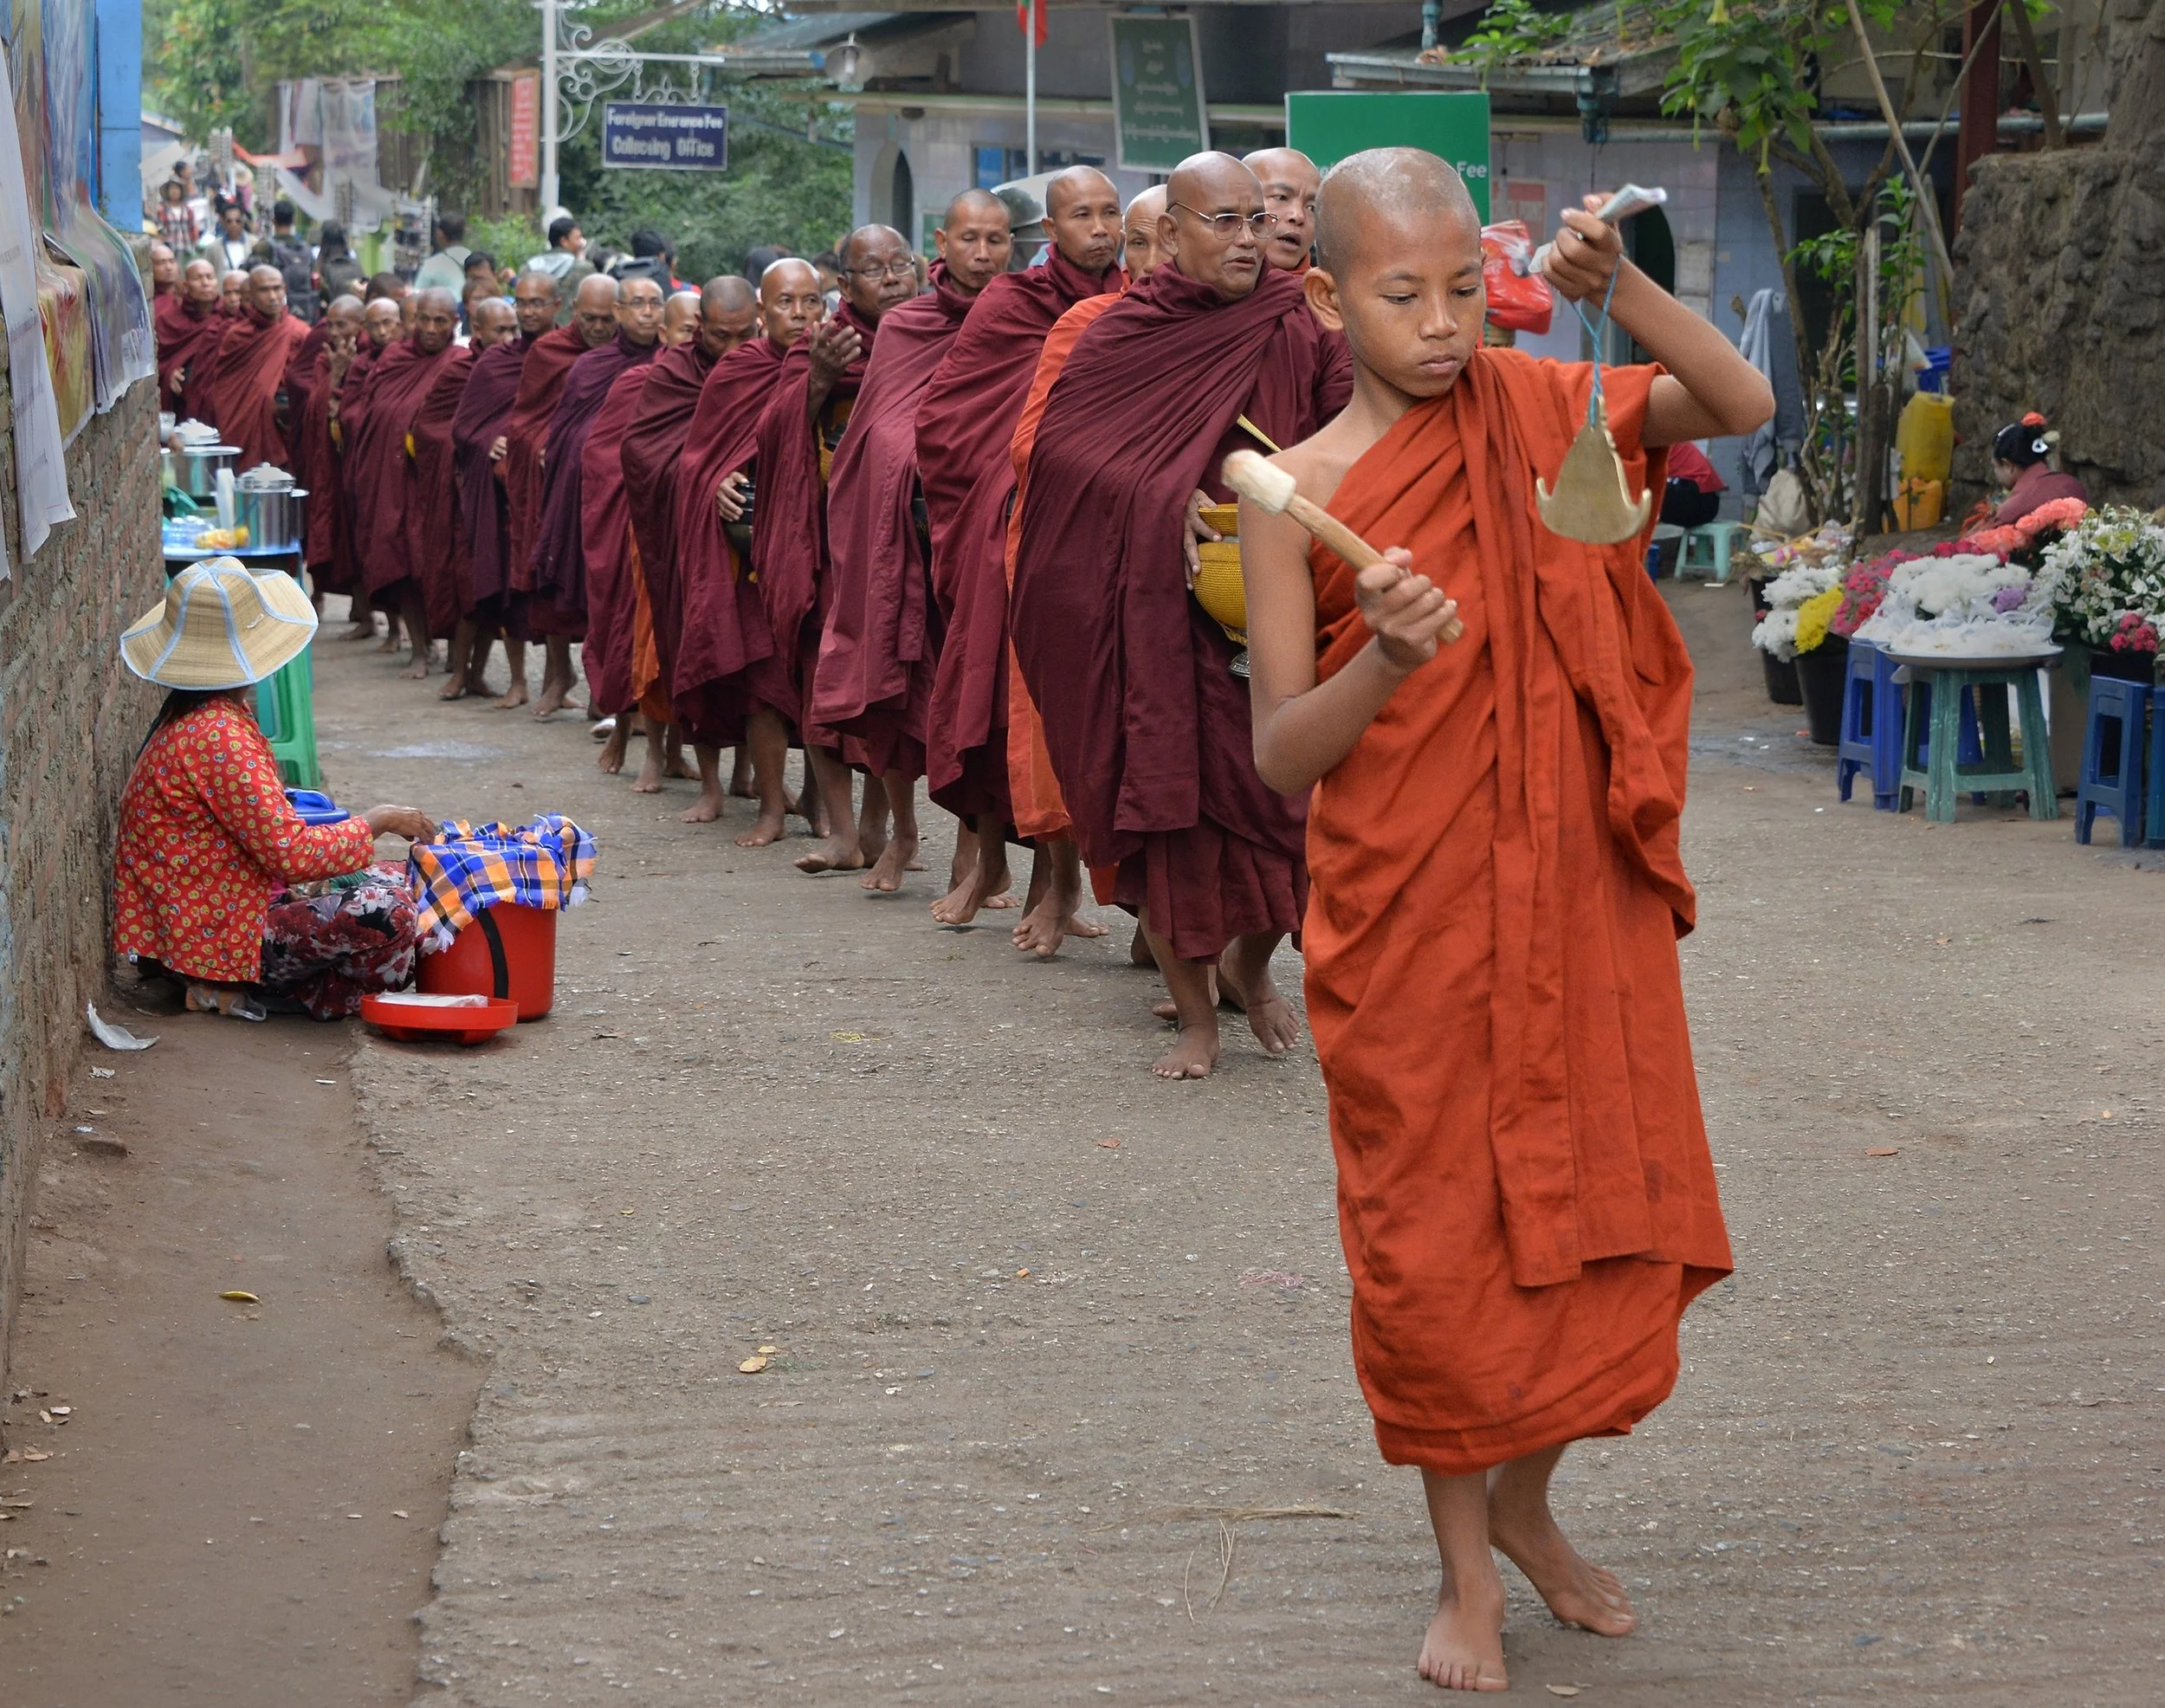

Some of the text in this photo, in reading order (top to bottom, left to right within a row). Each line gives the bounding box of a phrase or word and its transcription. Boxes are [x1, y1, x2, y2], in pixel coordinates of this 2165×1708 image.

[704, 113, 723, 129] Fee
[675, 137, 714, 158] Office
[1457, 161, 1487, 178] Fee
